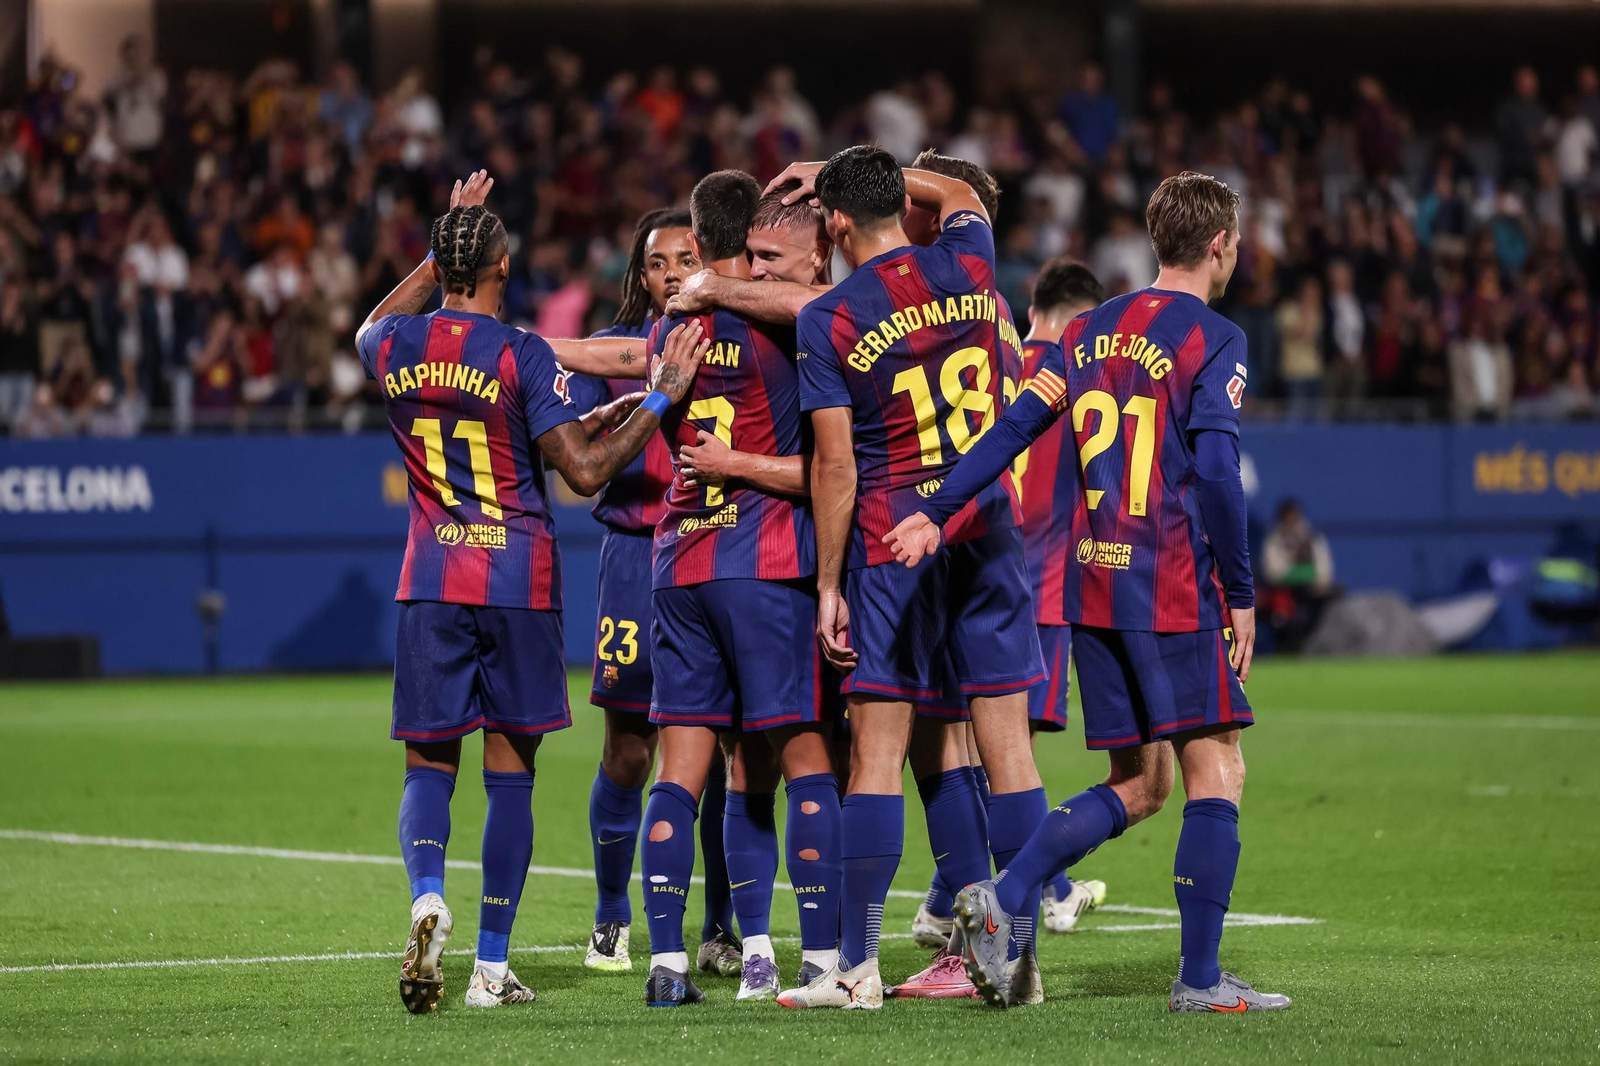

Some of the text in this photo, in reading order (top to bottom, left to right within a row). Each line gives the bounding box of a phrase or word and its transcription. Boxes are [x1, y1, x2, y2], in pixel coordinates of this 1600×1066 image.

[847, 289, 996, 373] GERARD MARTÍN
[1074, 333, 1173, 380] F. DE JONG
[384, 361, 501, 405] RAPHINHA
[891, 346, 995, 466] 18
[411, 418, 503, 521] 11
[687, 396, 735, 507] 7
[1071, 389, 1157, 517] 21
[0, 465, 152, 512] CELONA
[465, 533, 507, 546] ACNUR
[598, 616, 639, 665] 23
[653, 885, 685, 896] BARÇA
